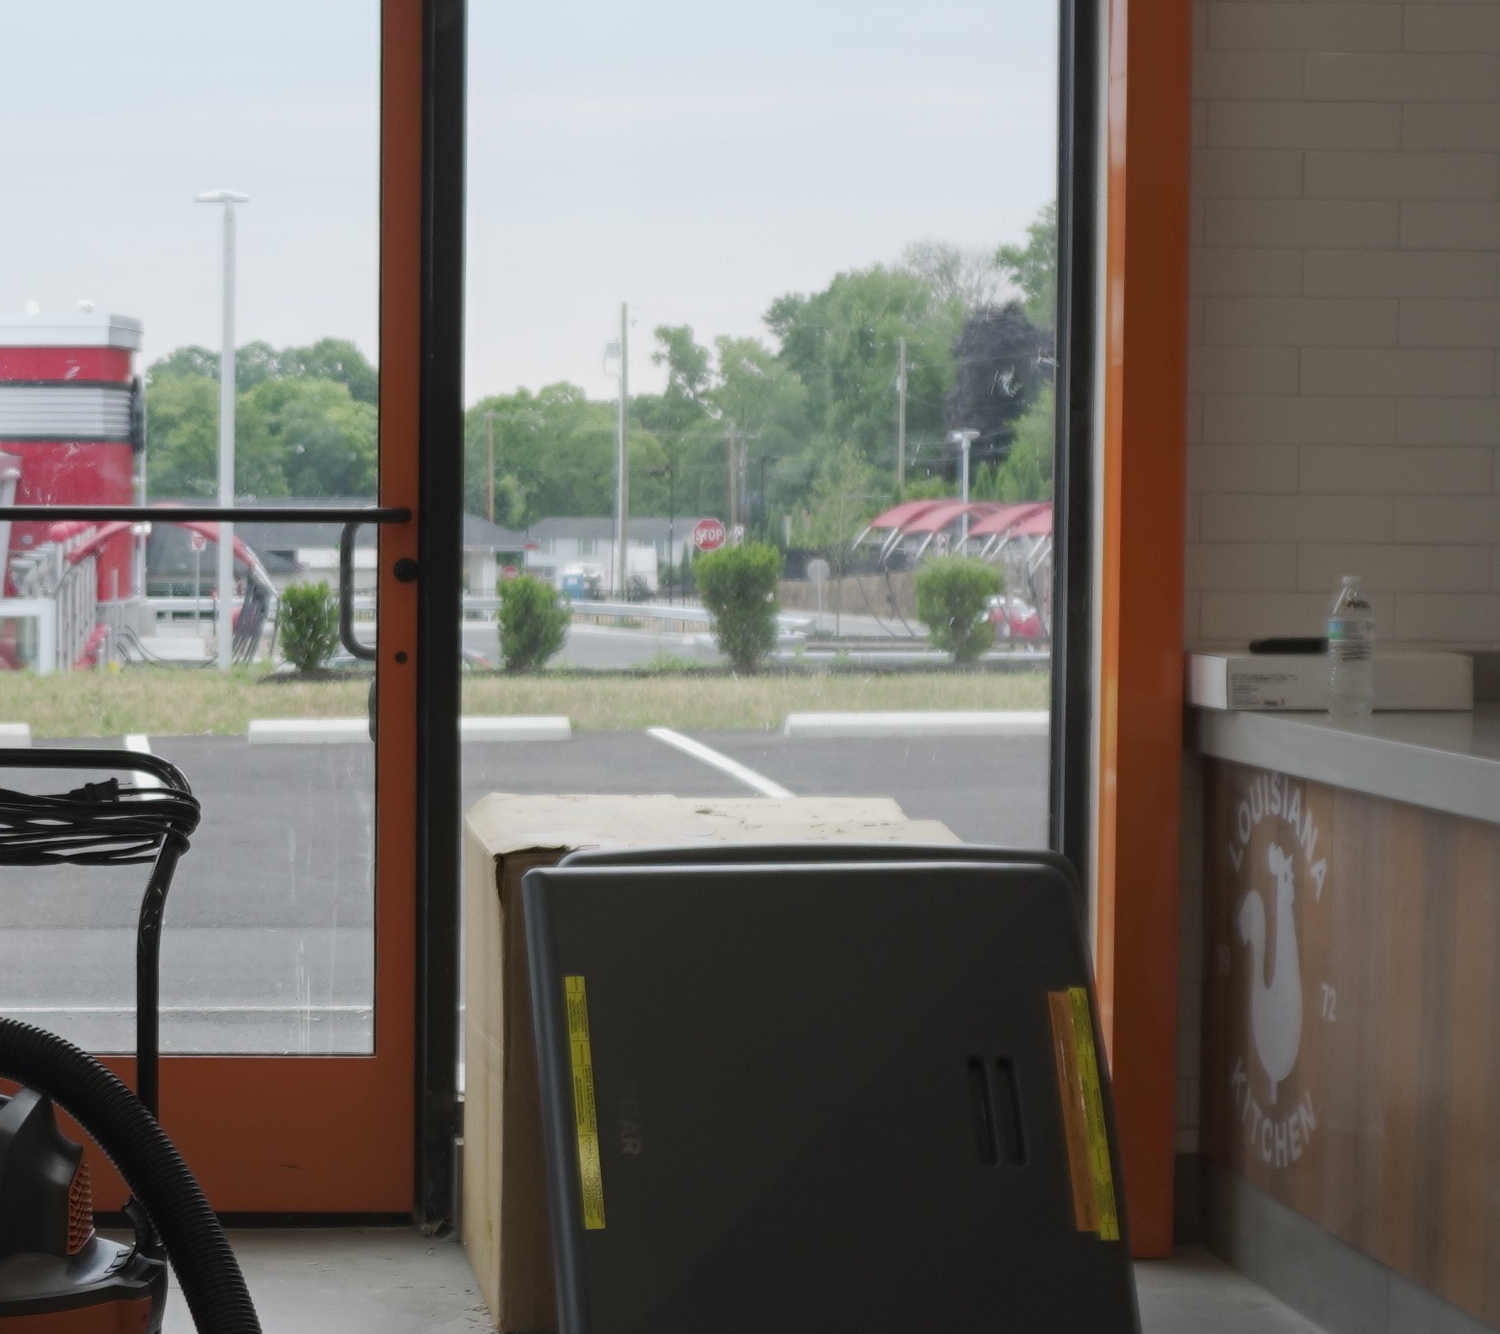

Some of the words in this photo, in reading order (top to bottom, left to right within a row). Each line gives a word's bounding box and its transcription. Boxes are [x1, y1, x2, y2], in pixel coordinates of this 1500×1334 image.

[695, 528, 723, 542] STOP
[1228, 772, 1328, 902] LOUISIANA
[1320, 982, 1337, 1022] 72
[1230, 1056, 1317, 1168] KITCHEN
